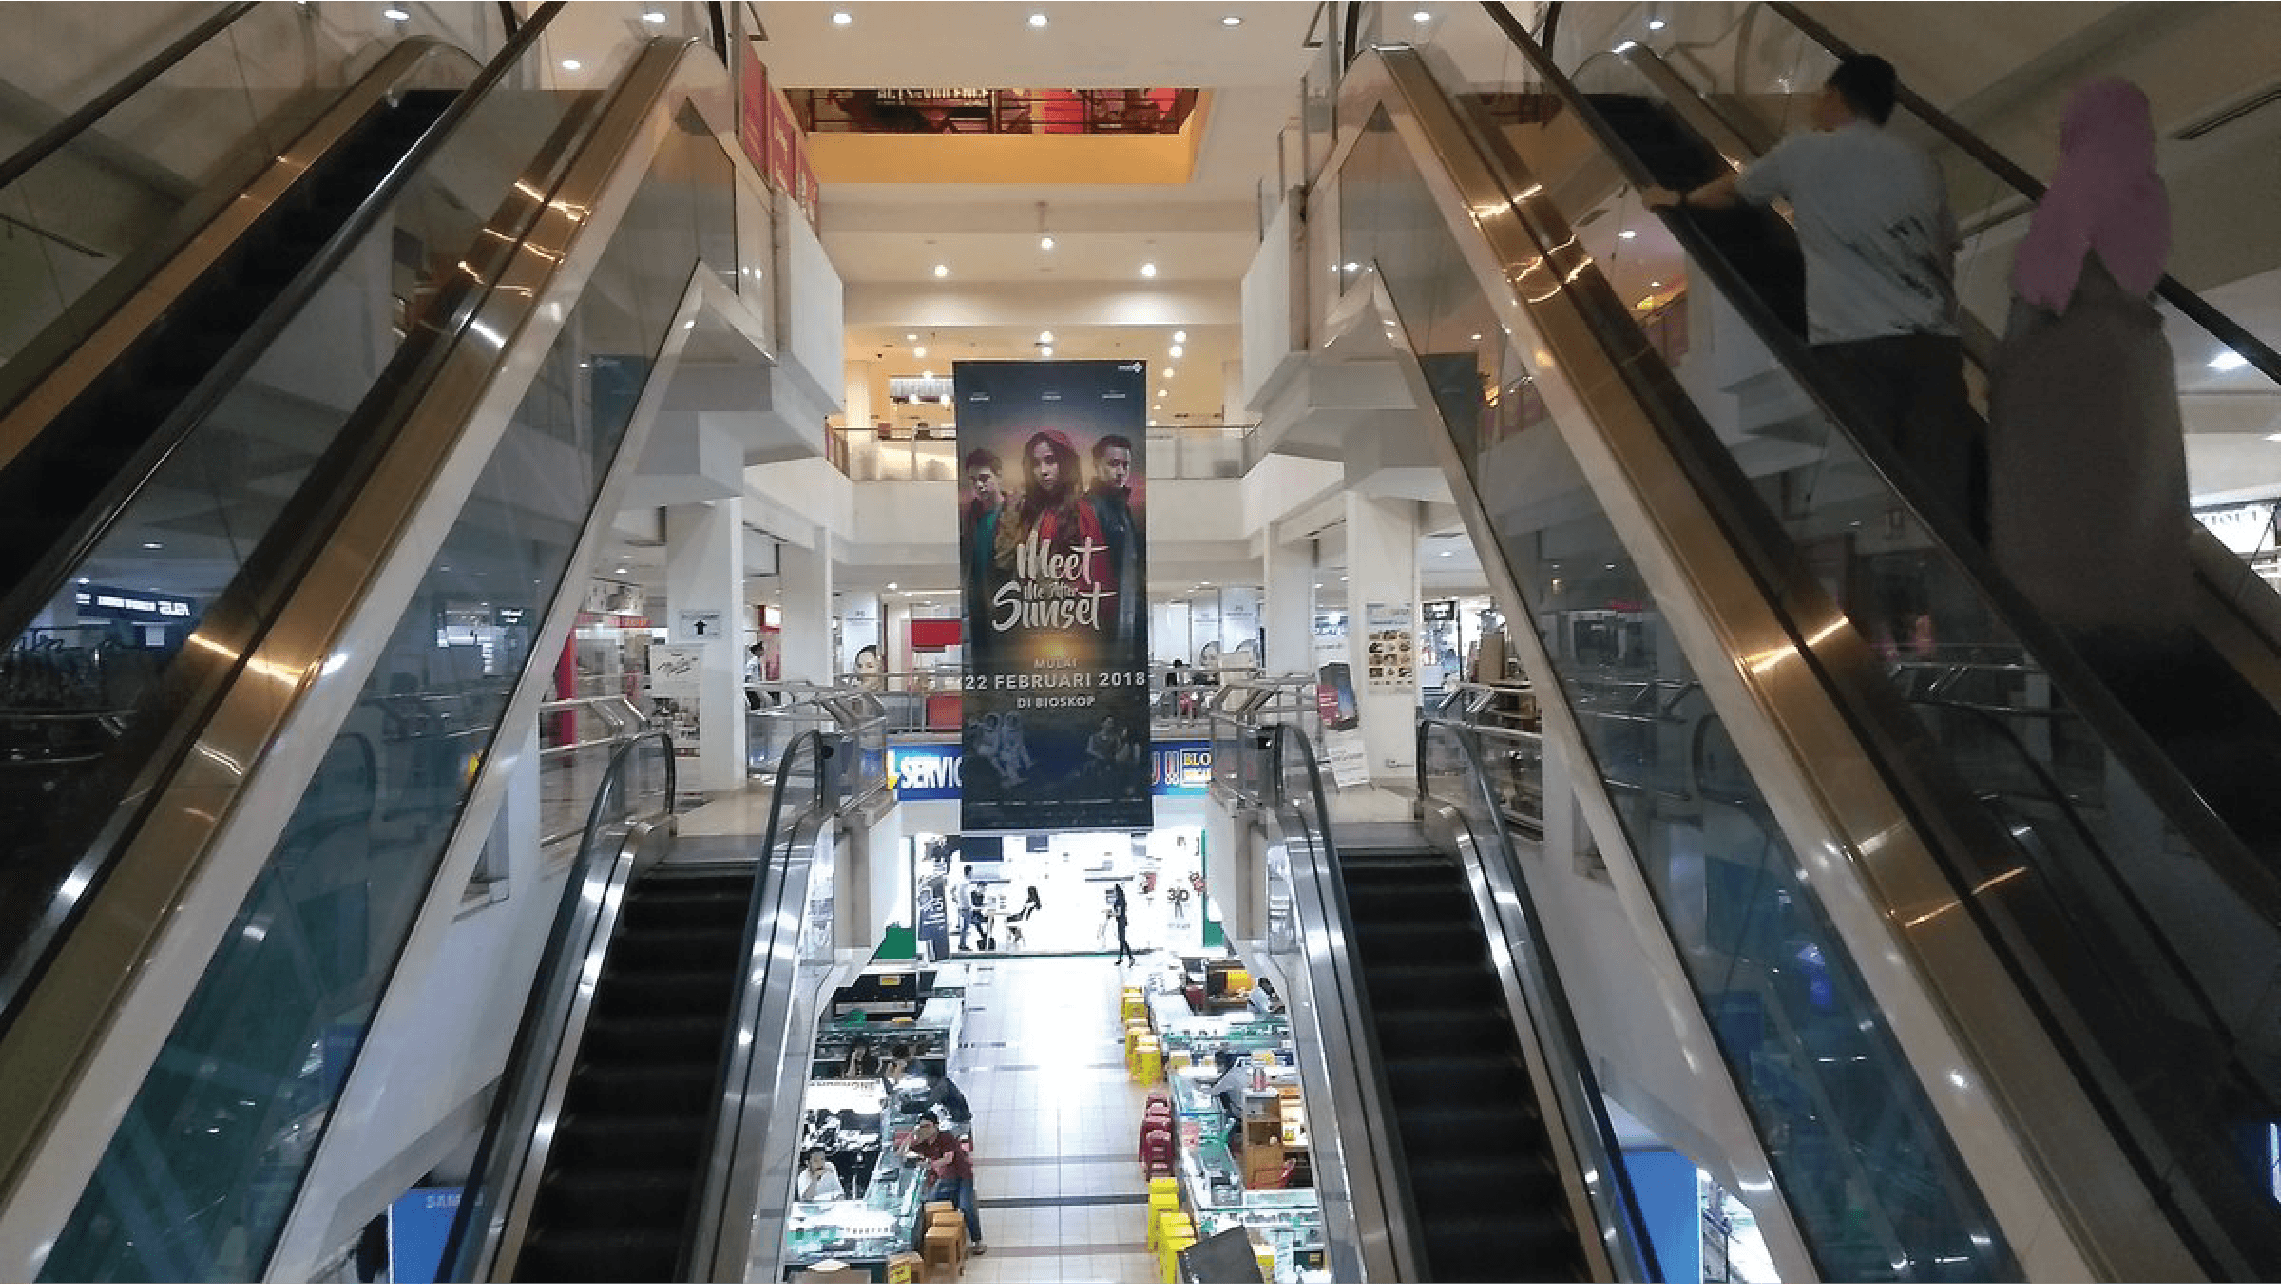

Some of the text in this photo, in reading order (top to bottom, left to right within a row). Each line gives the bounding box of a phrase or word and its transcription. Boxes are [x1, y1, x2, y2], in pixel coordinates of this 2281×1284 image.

[1016, 530, 1109, 584] Meet
[992, 580, 1117, 631] Sunset
[965, 671, 1145, 690] 22 FEBRUARI 2018
[1035, 695, 1095, 709] BIOSKOP
